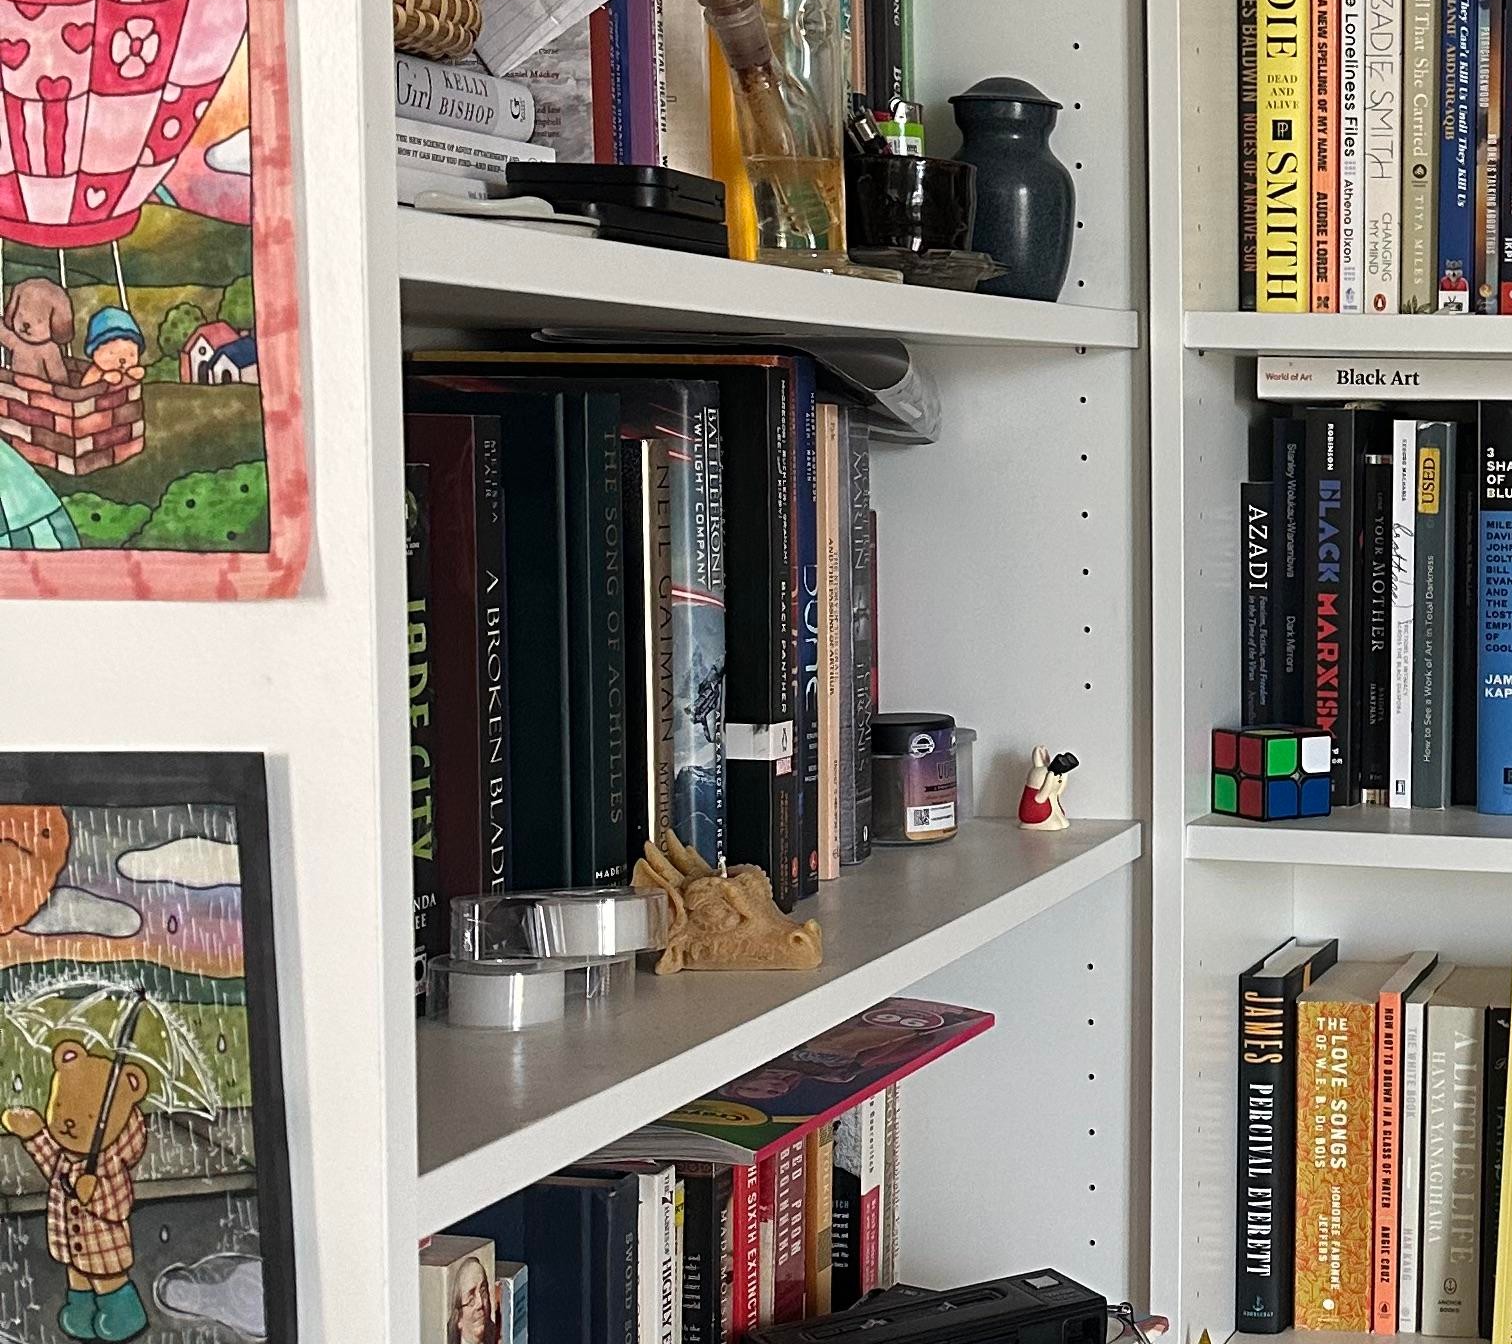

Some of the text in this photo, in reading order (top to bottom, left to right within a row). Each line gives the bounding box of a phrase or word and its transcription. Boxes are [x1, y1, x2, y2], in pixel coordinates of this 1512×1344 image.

[442, 71, 490, 97] KELLY
[1267, 75, 1298, 84] DEAD
[1344, 15, 1356, 110] Loneliness
[439, 97, 495, 125] BISHOP
[1265, 100, 1298, 109] ALIVE
[1270, 88, 1294, 97] AND
[1344, 114, 1355, 156] Files
[1265, 151, 1298, 303] SMITH
[1342, 179, 1354, 263] Athena Dixon
[1336, 370, 1420, 385] Black Art
[693, 412, 706, 585] TWILIGHT COMPANY
[1421, 457, 1436, 505] USED
[1248, 505, 1267, 590] AZADI
[1244, 991, 1284, 1277] JAMES PERCIVAL EVERETT
